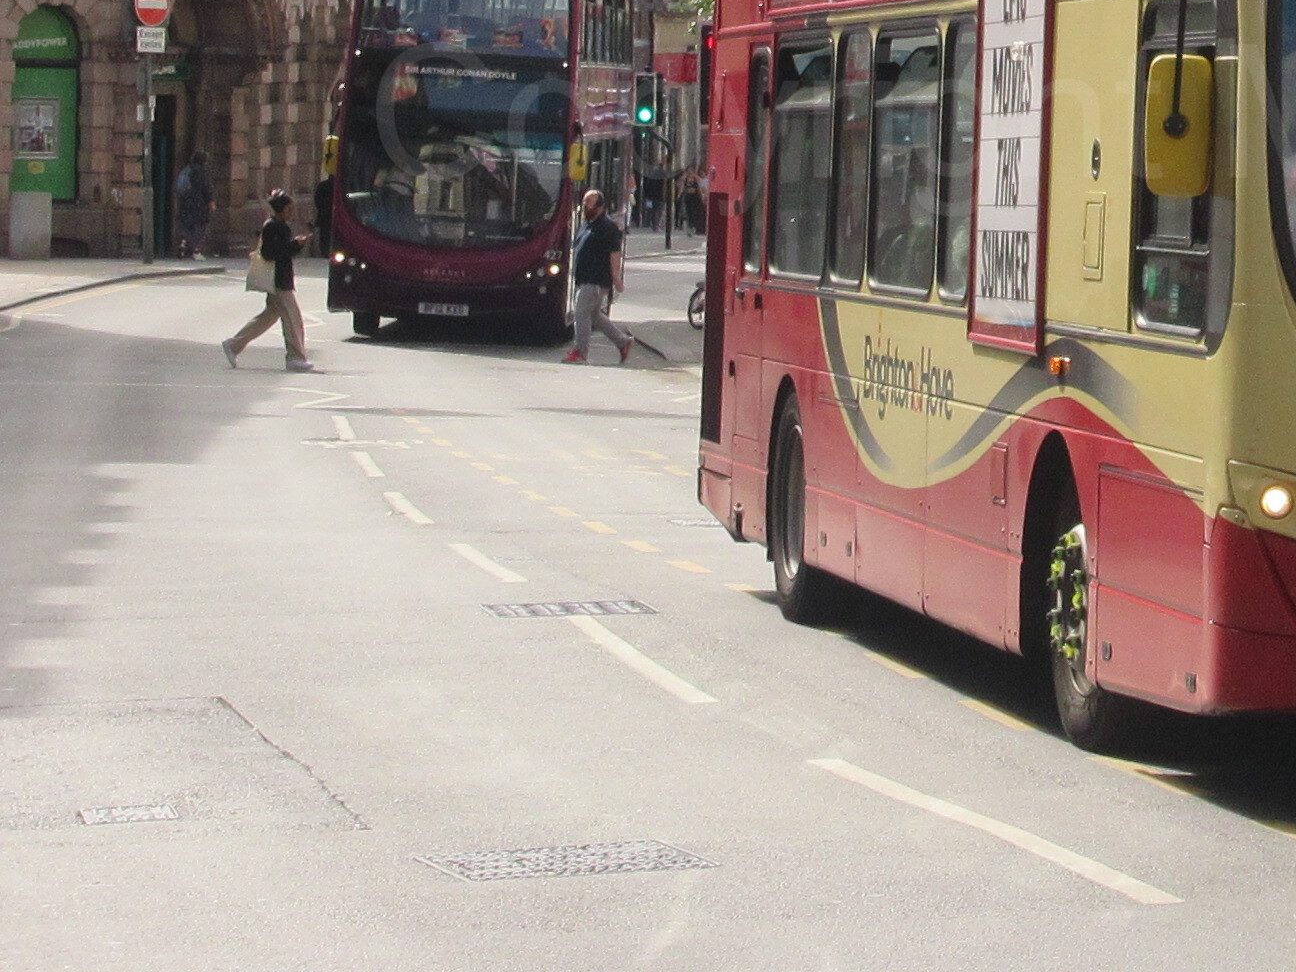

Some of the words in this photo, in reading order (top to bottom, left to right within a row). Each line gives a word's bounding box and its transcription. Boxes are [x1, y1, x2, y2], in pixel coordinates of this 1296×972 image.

[405, 65, 419, 74] SIR
[420, 67, 456, 76] ARTHUR
[456, 69, 487, 78] CONAN
[488, 70, 517, 80] DOYLE
[991, 42, 1034, 117] MOVIES
[995, 137, 1022, 209] THIS
[980, 229, 1031, 301] SUMMER
